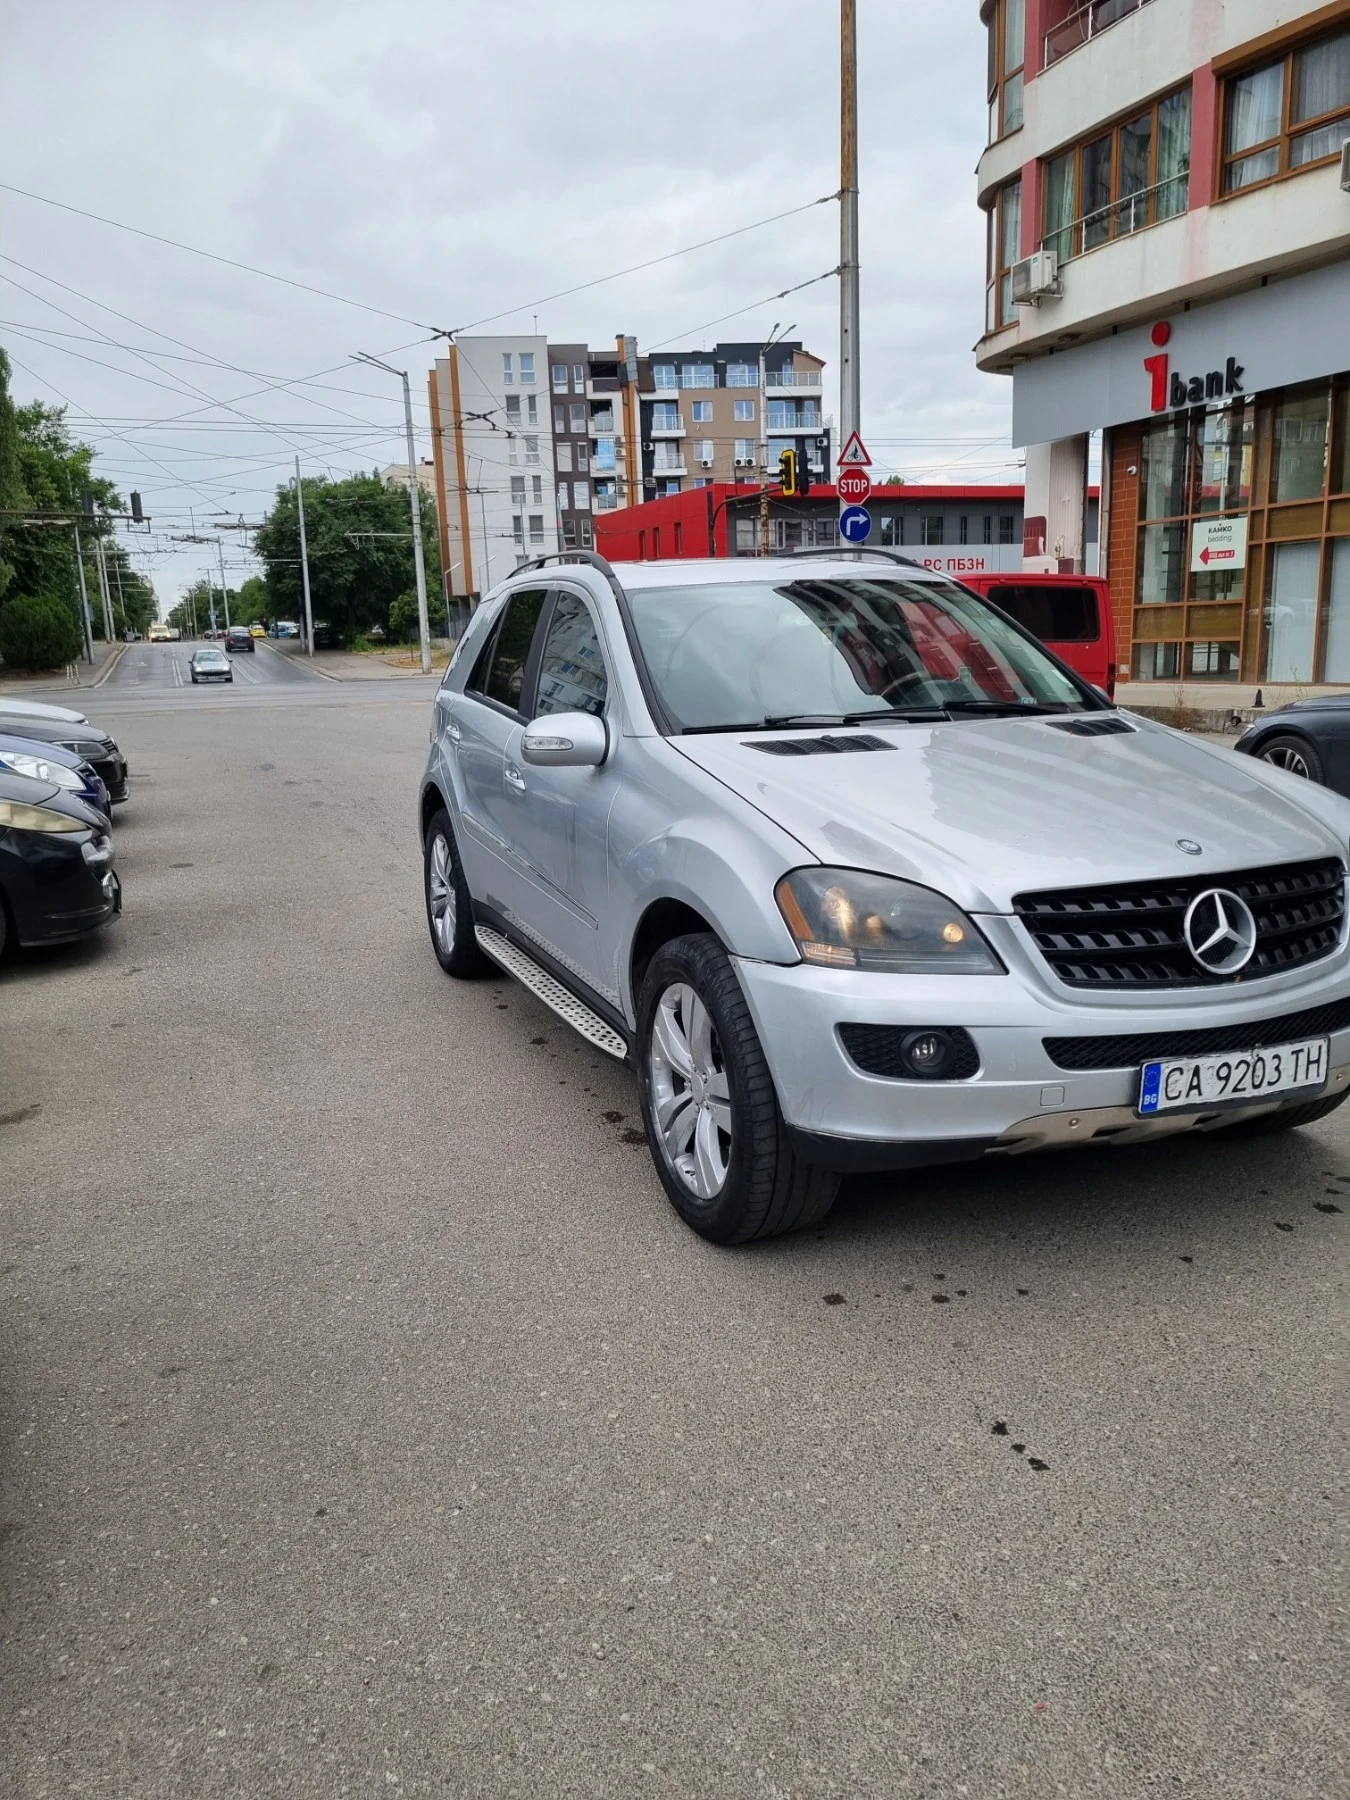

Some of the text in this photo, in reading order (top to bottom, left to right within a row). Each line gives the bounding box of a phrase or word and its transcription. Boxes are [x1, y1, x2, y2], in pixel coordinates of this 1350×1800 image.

[840, 479, 868, 493] STOP
[1207, 535, 1233, 543] bedding
[947, 557, 985, 571] ПБЗН
[1165, 1044, 1323, 1101] CA 9203 TH
[1143, 1093, 1157, 1105] BG
